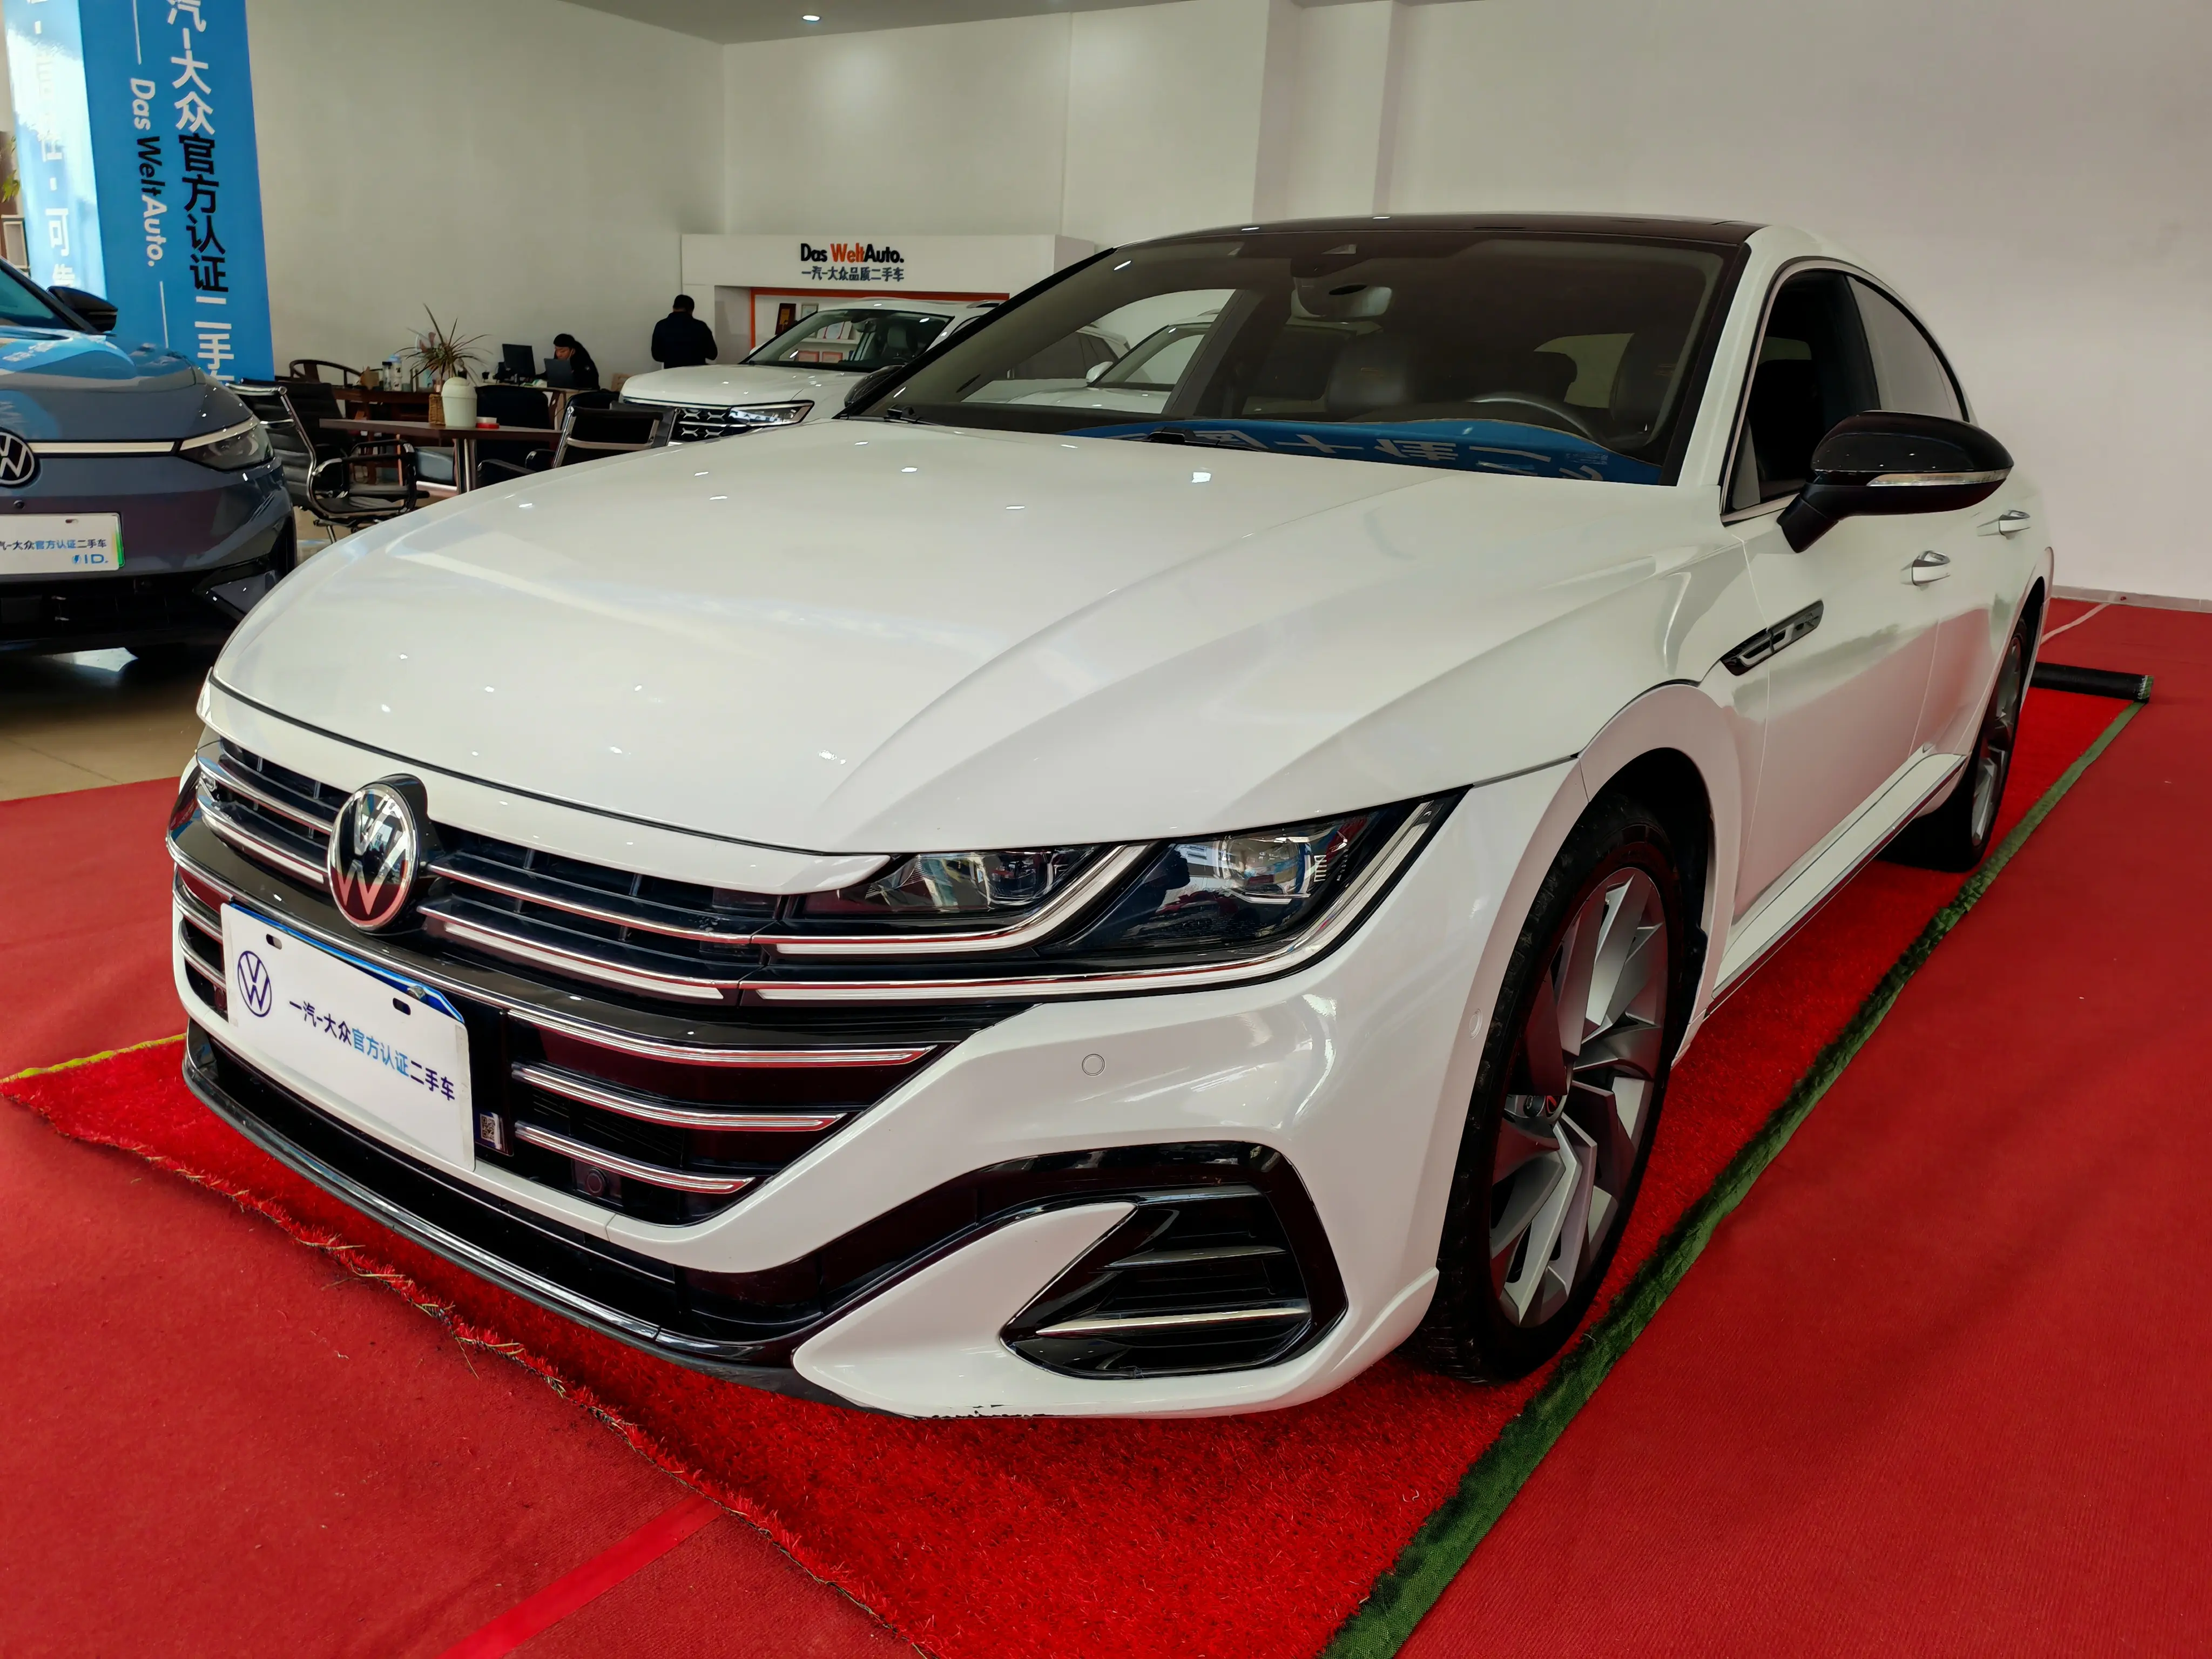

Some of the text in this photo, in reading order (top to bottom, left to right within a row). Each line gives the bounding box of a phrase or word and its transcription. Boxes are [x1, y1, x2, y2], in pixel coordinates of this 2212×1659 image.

[131, 78, 167, 267] Das WeltAuto.
[801, 242, 905, 263] Das WeltAuto.
[289, 1000, 455, 1102] 一汽-大众官方认证二手车
